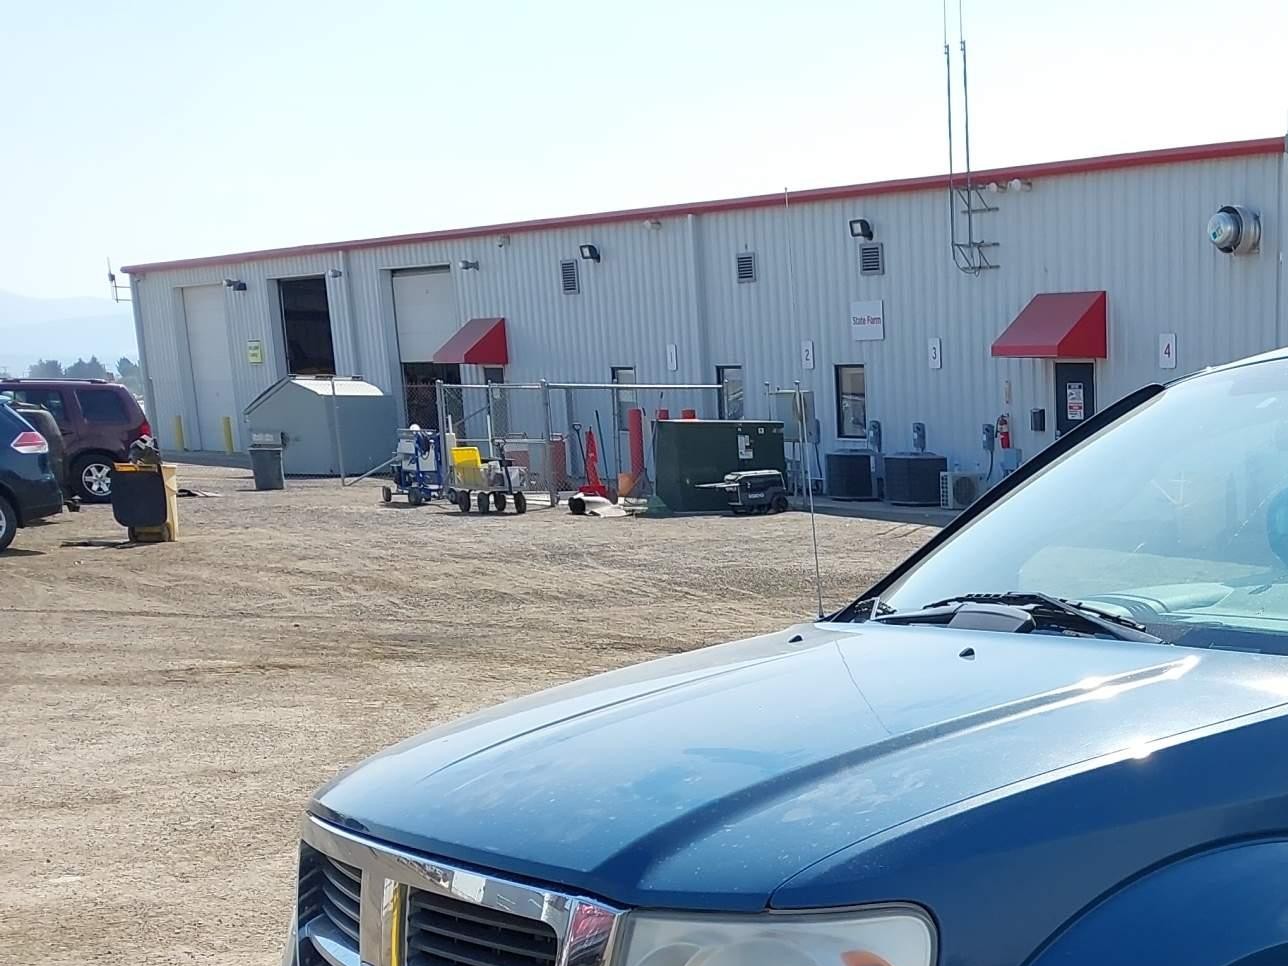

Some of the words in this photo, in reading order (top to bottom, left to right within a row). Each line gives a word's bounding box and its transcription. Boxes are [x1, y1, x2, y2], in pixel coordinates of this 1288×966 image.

[852, 316, 866, 326] State
[866, 315, 881, 325] Farm
[804, 348, 811, 361] 2
[932, 346, 937, 360] 3
[1163, 343, 1171, 358] 4
